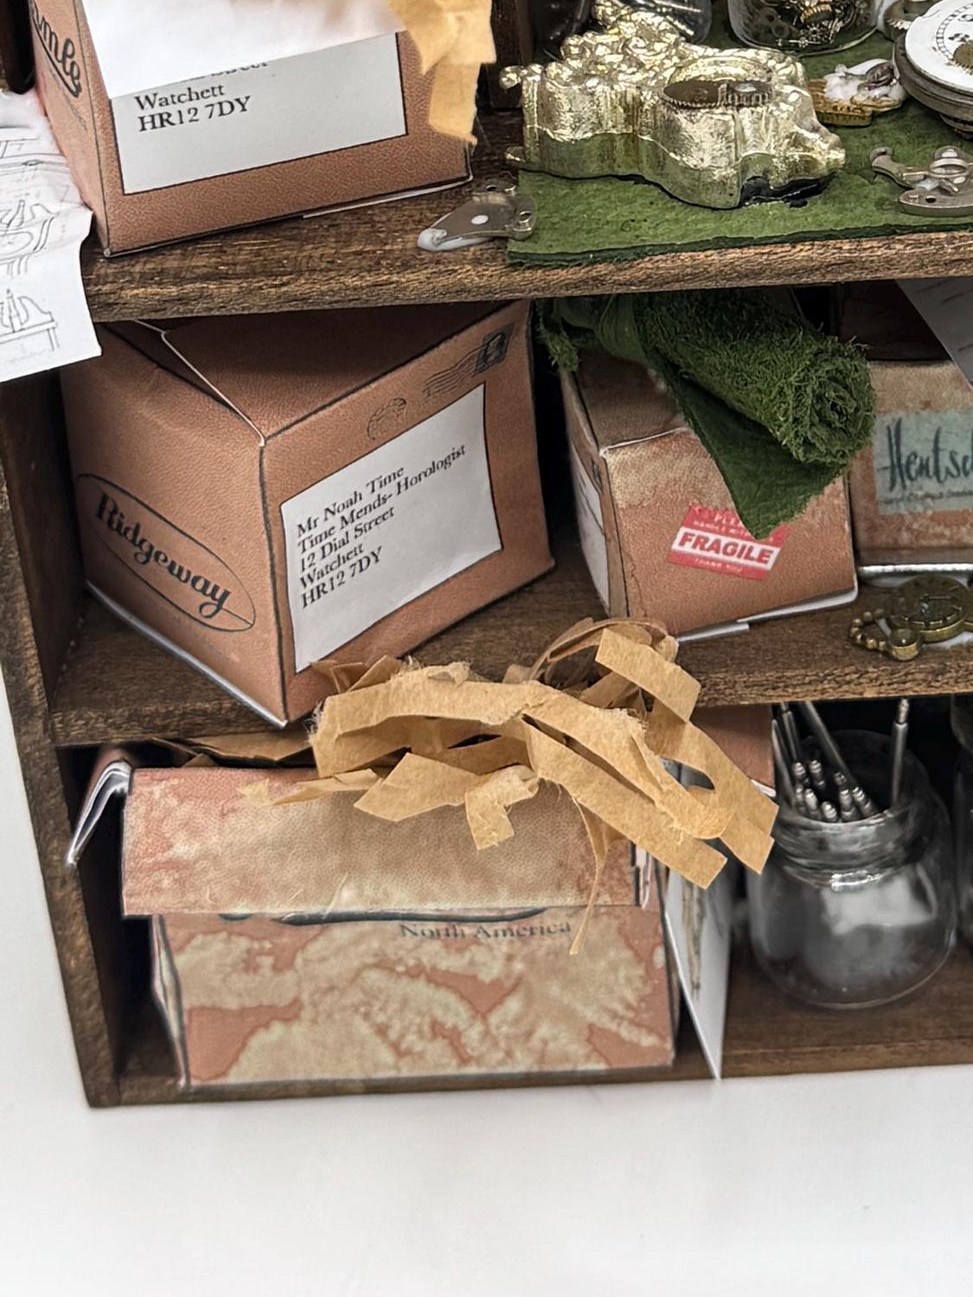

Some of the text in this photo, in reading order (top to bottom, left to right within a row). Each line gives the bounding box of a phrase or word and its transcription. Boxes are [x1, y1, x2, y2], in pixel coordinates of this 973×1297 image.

[134, 83, 227, 112] Watchett
[137, 95, 252, 133] HR12 7DY
[297, 466, 405, 539] Mr Noah Time
[298, 444, 467, 555] Time Mends- Horologist
[97, 490, 232, 620] Ridgeway
[300, 505, 396, 573] 12 Dial Street
[300, 542, 365, 590] Watchett
[678, 531, 774, 565] FRAGILE
[301, 544, 384, 610] HR12 7DY
[399, 921, 572, 940] North America
